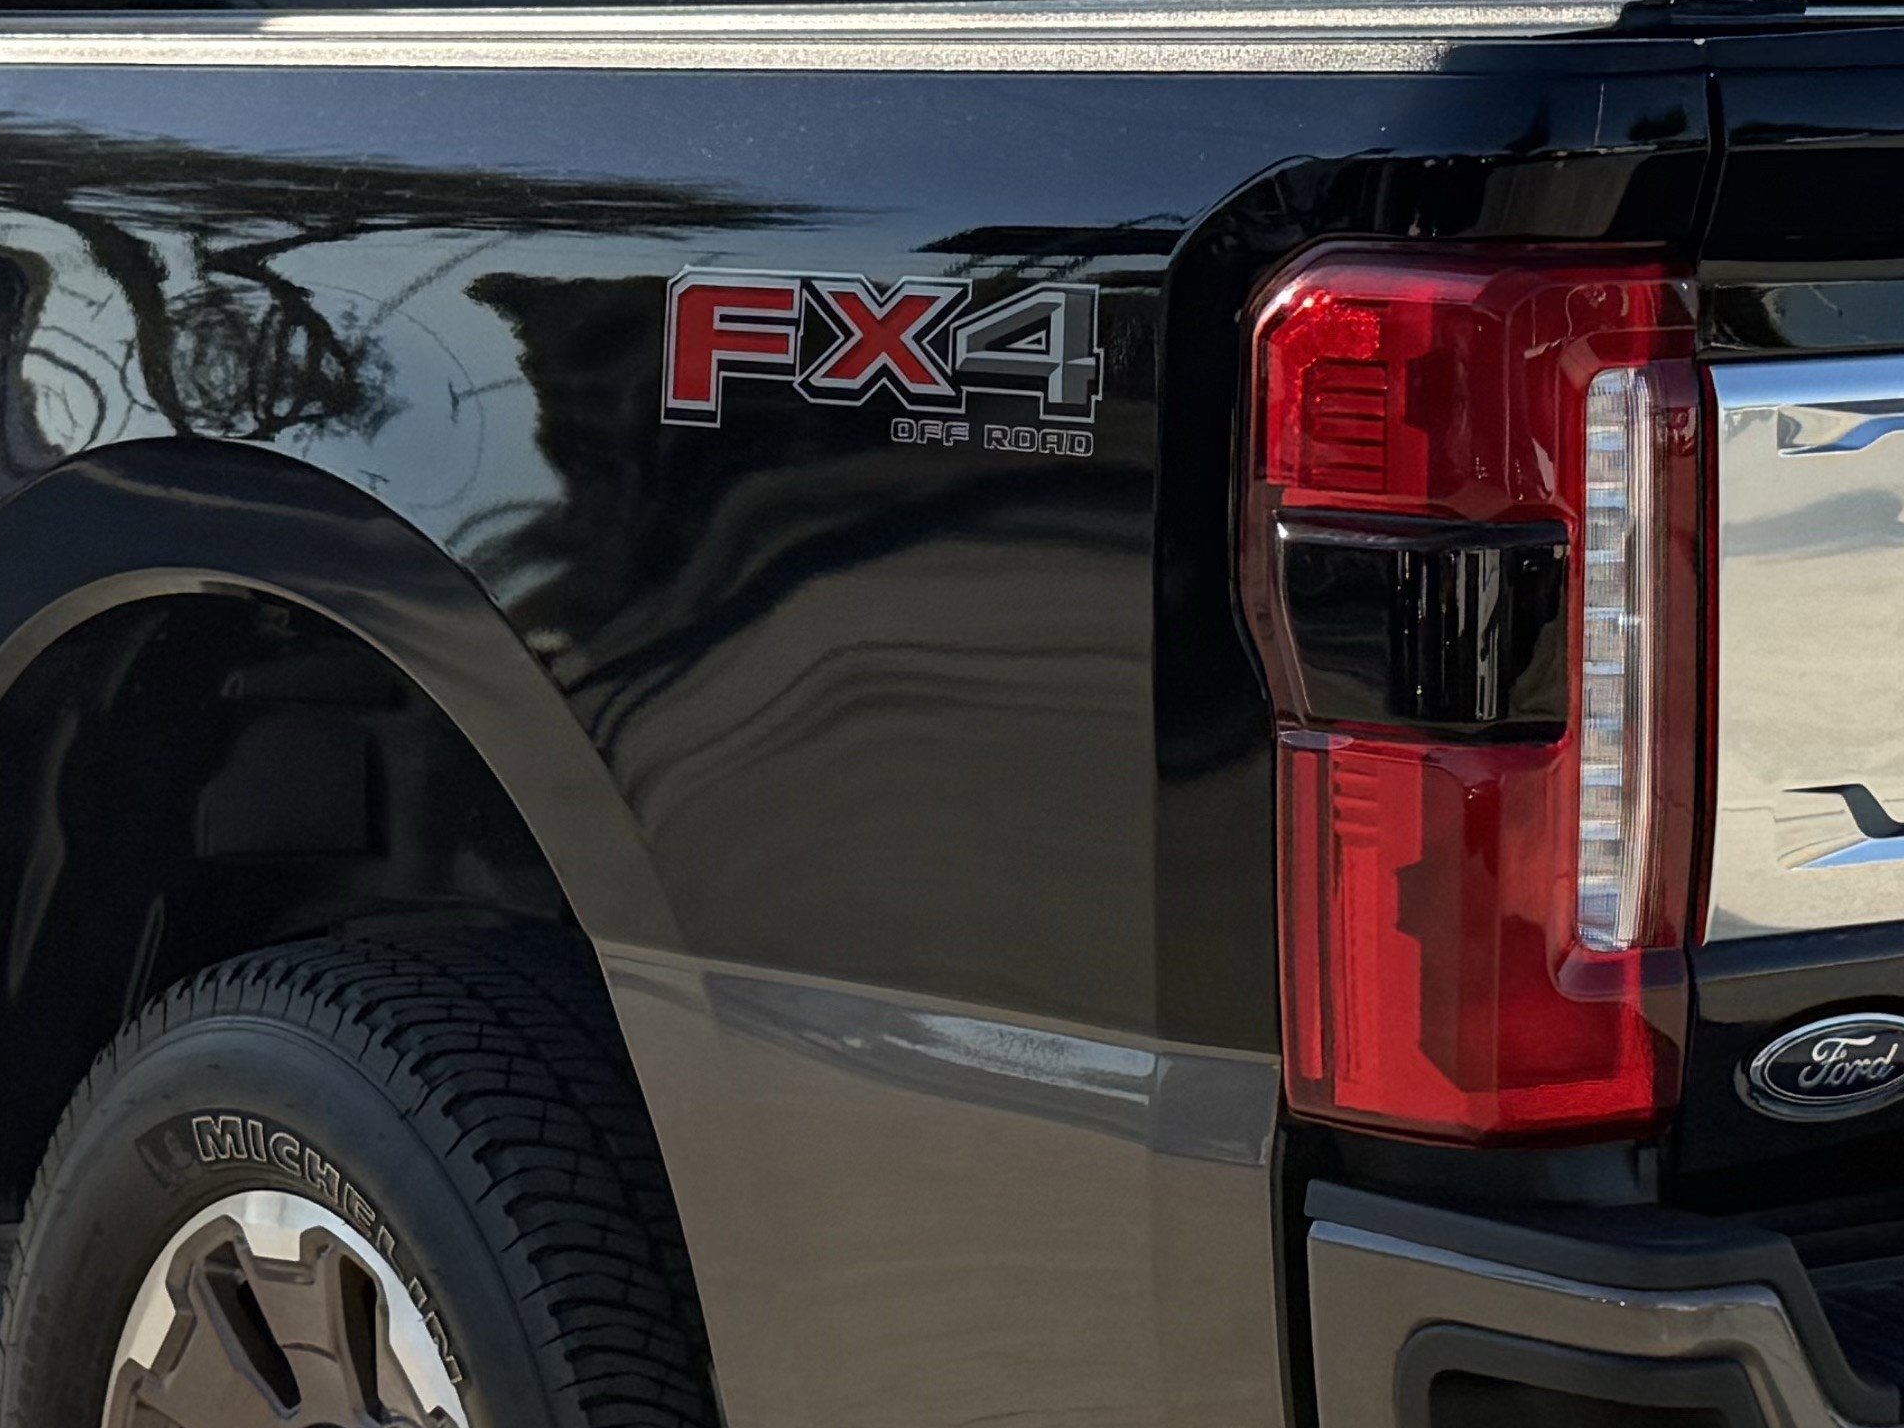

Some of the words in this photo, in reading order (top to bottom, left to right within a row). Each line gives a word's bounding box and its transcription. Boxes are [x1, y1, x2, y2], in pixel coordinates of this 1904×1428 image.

[660, 264, 1104, 429] FX4
[890, 417, 970, 446] OFF
[983, 424, 1094, 457] ROAD
[1797, 1034, 1899, 1089] Ford
